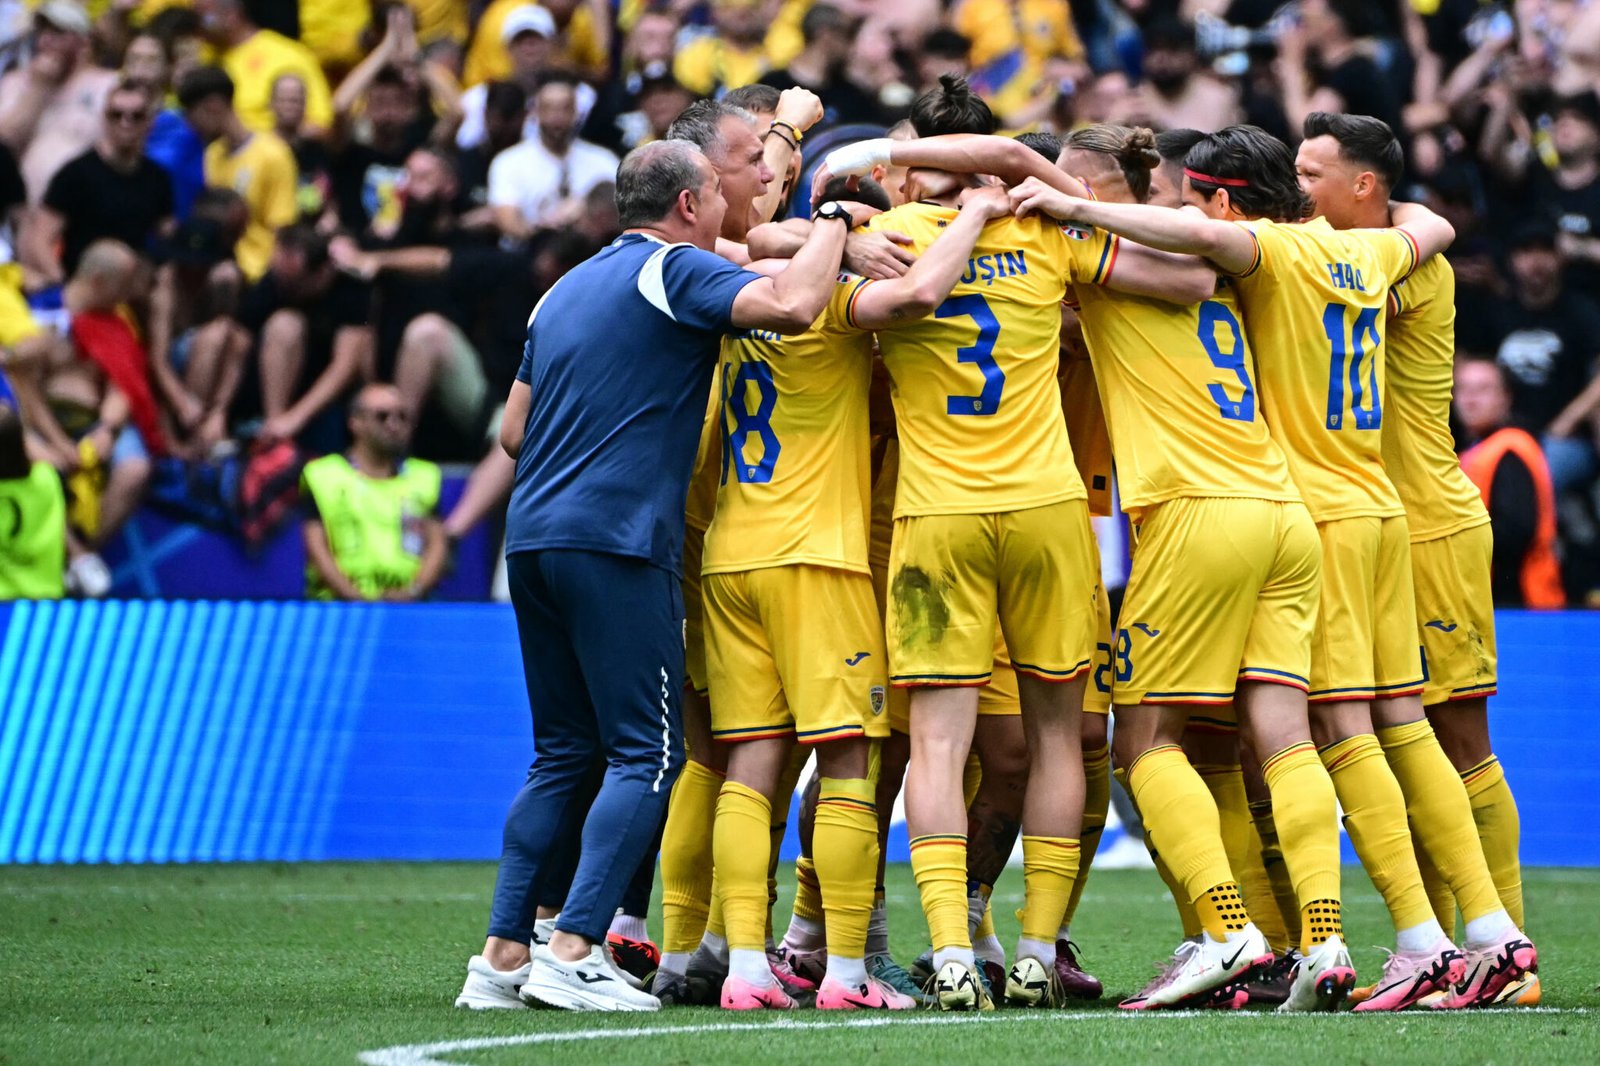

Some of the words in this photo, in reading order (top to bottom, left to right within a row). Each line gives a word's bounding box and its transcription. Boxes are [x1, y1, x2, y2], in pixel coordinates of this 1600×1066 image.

[960, 250, 1028, 286] UȘIN
[935, 293, 1006, 416] 3
[1197, 300, 1255, 422] 9
[1322, 302, 1382, 430] 10
[720, 360, 782, 487] 18
